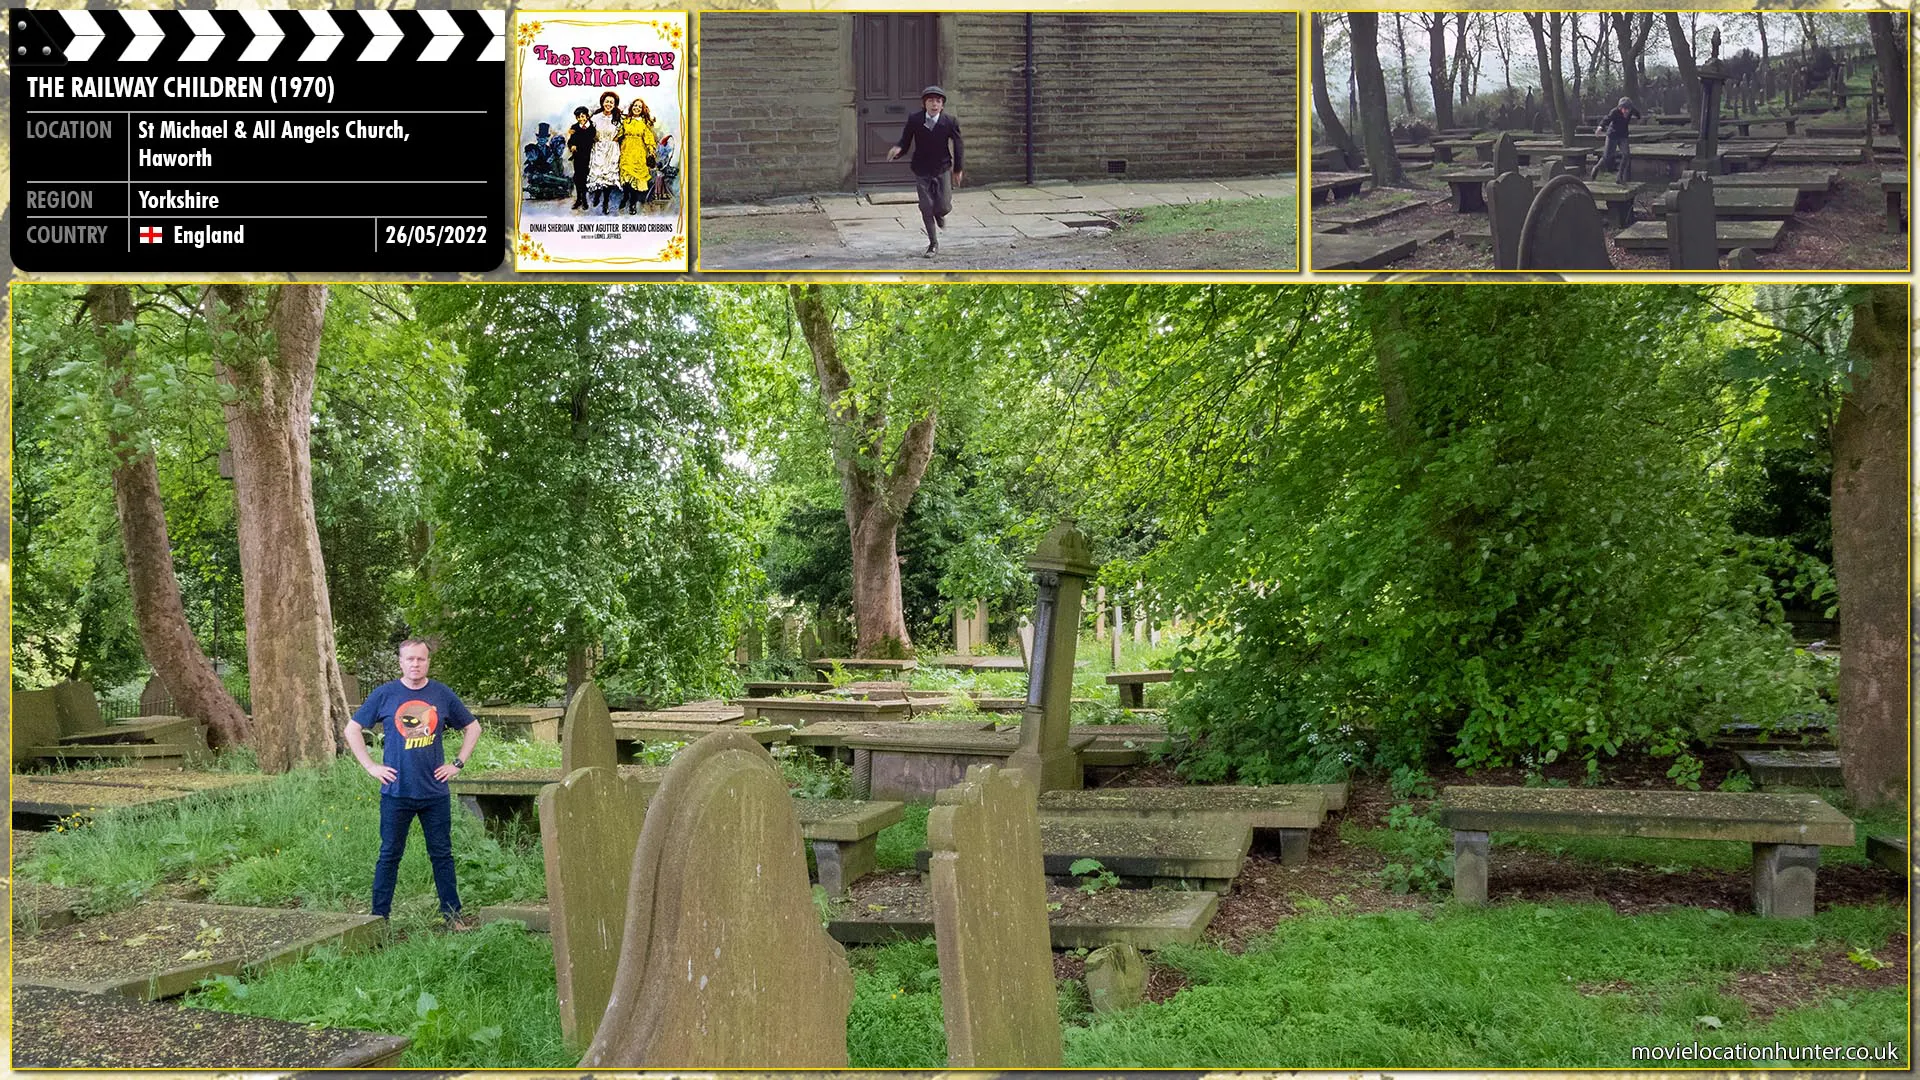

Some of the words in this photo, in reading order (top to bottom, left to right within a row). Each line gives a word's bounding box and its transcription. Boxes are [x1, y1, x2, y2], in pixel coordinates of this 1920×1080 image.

[533, 45, 570, 66] The
[572, 45, 675, 70] Railway
[550, 67, 660, 87] Children
[529, 223, 547, 233] DINAH
[547, 223, 575, 233] SHERIDAN
[576, 223, 595, 233] JENNY
[595, 223, 620, 233] AGUTTER
[621, 223, 647, 233] BERNARD
